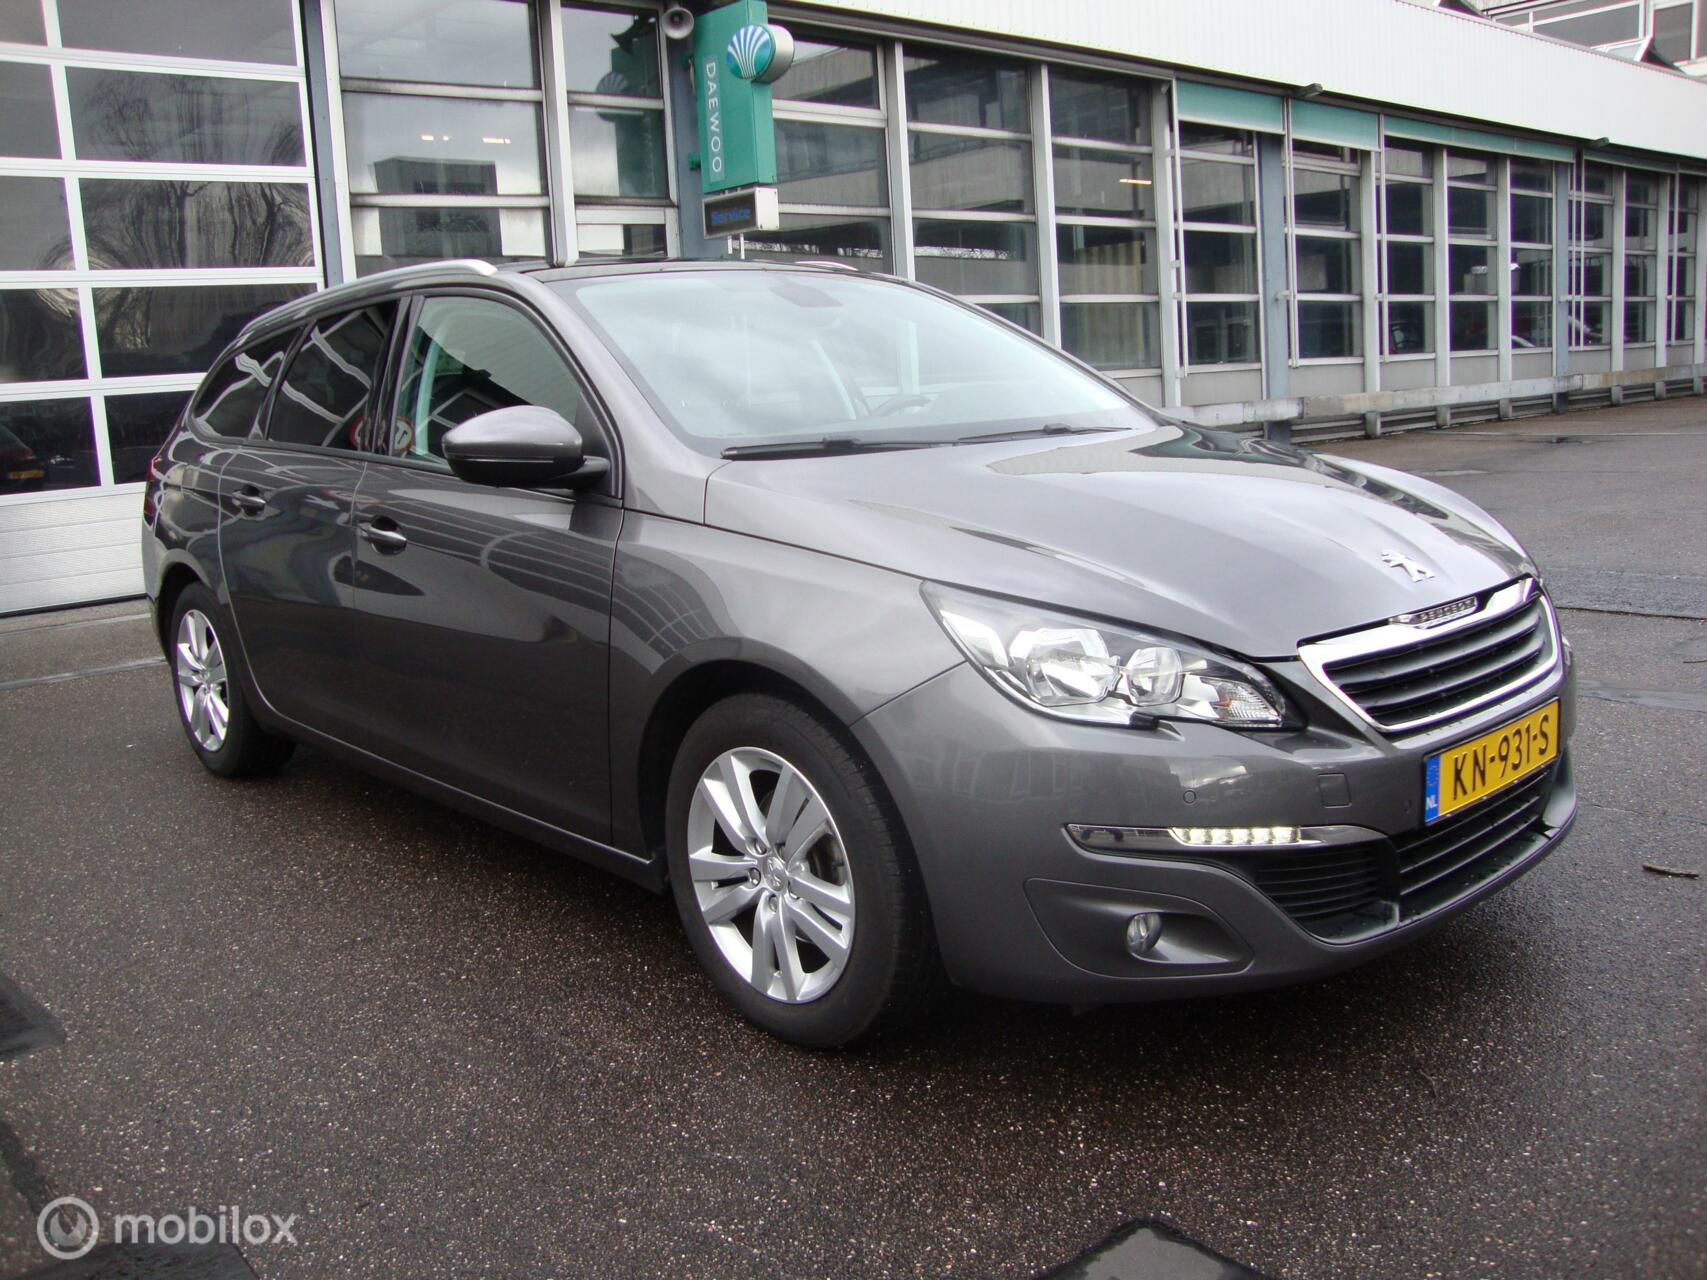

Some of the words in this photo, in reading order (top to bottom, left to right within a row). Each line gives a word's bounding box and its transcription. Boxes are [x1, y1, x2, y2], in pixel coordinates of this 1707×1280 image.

[706, 62, 722, 173] DAEWOO
[1453, 713, 1549, 800] KN-931-S
[1425, 794, 1438, 810] NL
